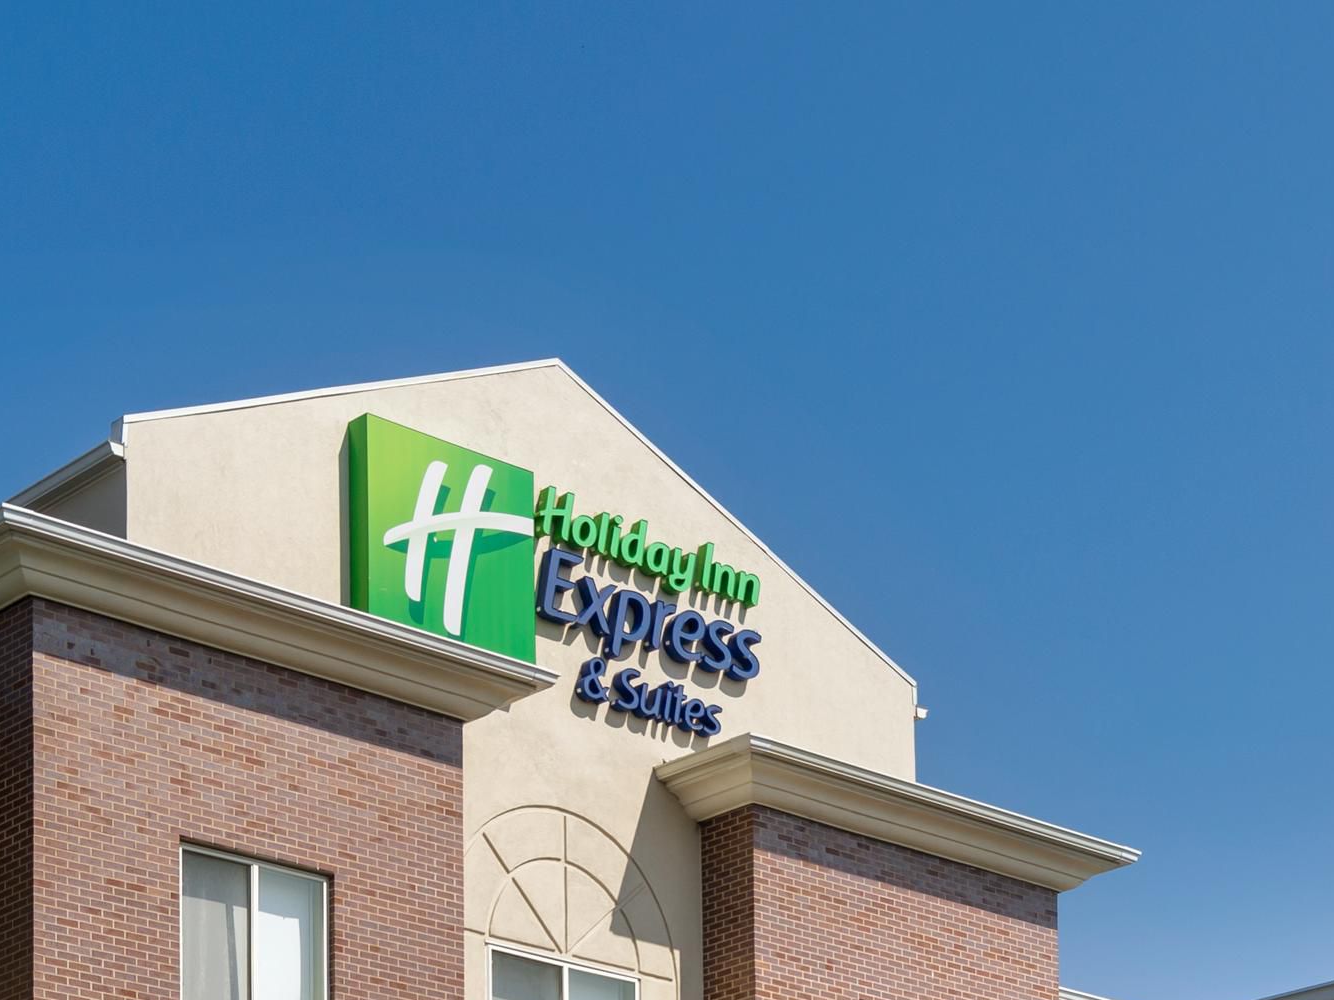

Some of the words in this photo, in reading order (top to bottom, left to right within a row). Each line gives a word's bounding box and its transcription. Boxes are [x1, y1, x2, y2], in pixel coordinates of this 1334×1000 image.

[536, 486, 696, 595] Holiday
[693, 542, 761, 608] Inn
[536, 547, 762, 682] Express
[576, 657, 609, 704] &
[610, 668, 723, 738] Suites
